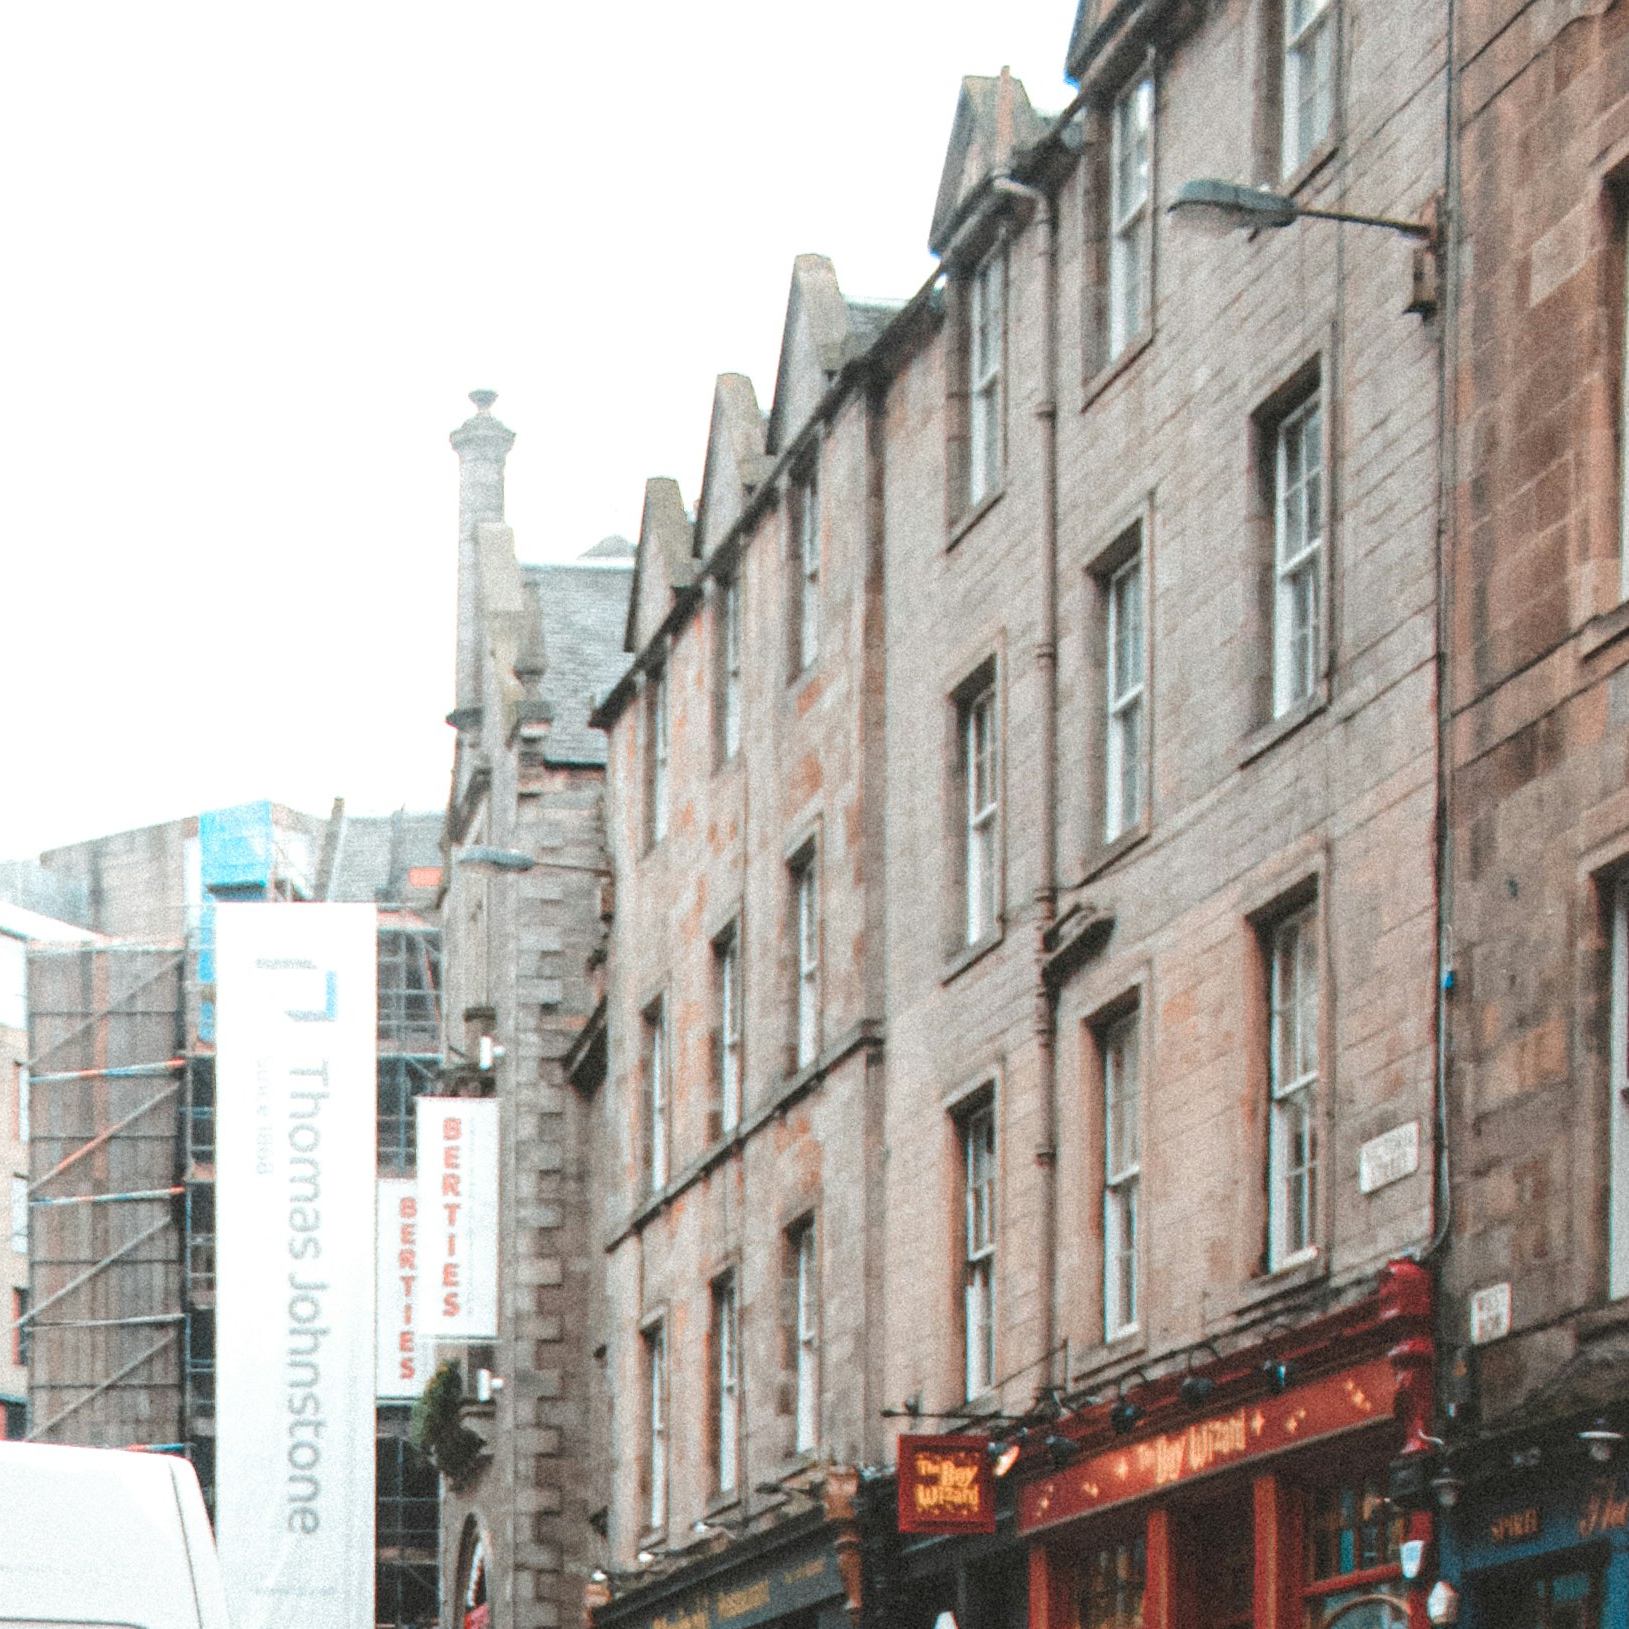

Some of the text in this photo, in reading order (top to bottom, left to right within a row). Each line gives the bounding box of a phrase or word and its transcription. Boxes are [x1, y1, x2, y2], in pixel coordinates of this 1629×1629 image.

[287, 1058, 331, 1536] Thomas Johnstone
[398, 1197, 417, 1380] BERTIES
[441, 1117, 462, 1318] BERTIES
